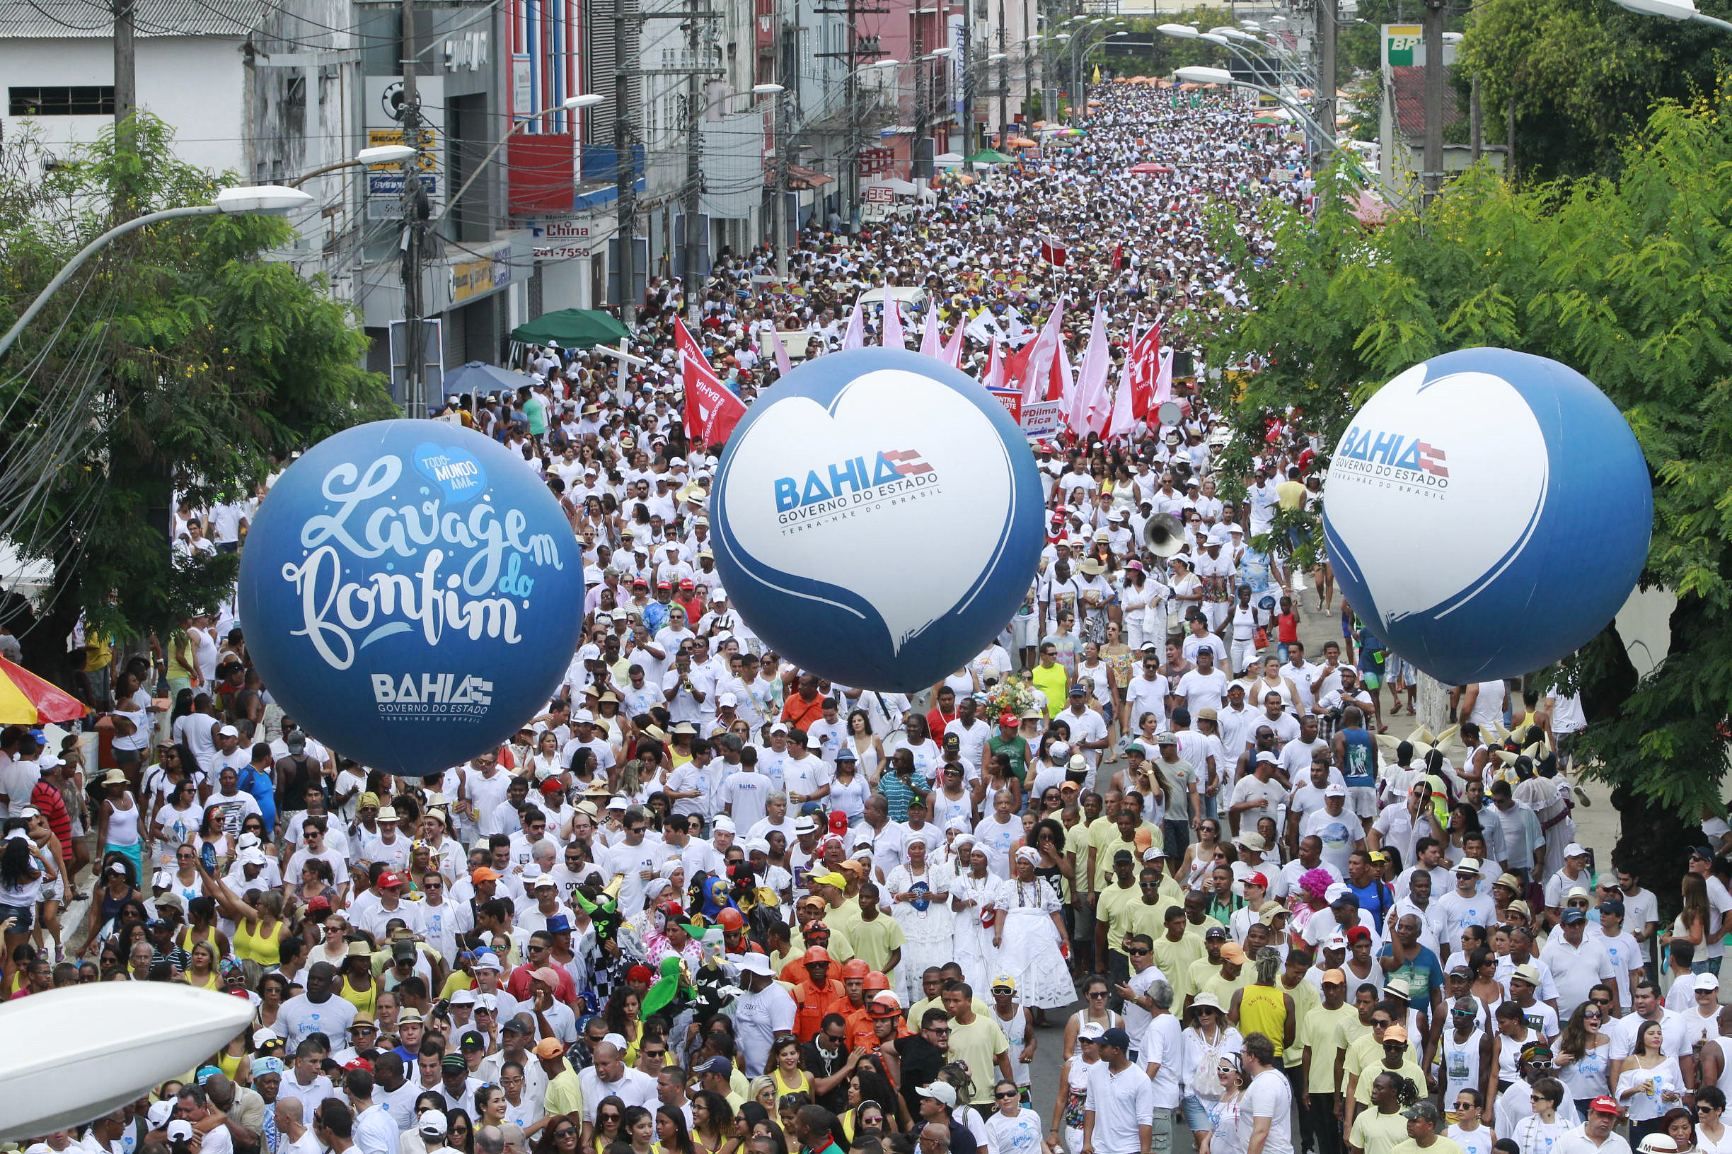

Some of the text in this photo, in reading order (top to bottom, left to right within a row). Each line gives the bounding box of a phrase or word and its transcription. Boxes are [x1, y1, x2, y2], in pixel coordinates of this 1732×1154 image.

[546, 221, 589, 237] China
[695, 378, 723, 402] BAHIA
[1022, 407, 1057, 418] #Dilma
[1027, 416, 1052, 426] Fica
[1339, 426, 1424, 472] BAHIA
[421, 455, 448, 470] TODO
[434, 460, 478, 482] MUNDO
[1335, 457, 1448, 489] GOVERNO DO ESTADO
[450, 476, 471, 491] AMA
[774, 450, 906, 513] BAHIA
[778, 472, 938, 525] GOVERNO DO ESTADO
[865, 502, 881, 513] DO
[892, 487, 943, 506] BRASIL
[300, 454, 564, 597] Lavagem
[499, 552, 534, 598] do
[371, 672, 475, 704] BAHIA
[378, 704, 488, 715] GOVERNO DO ESTADO
